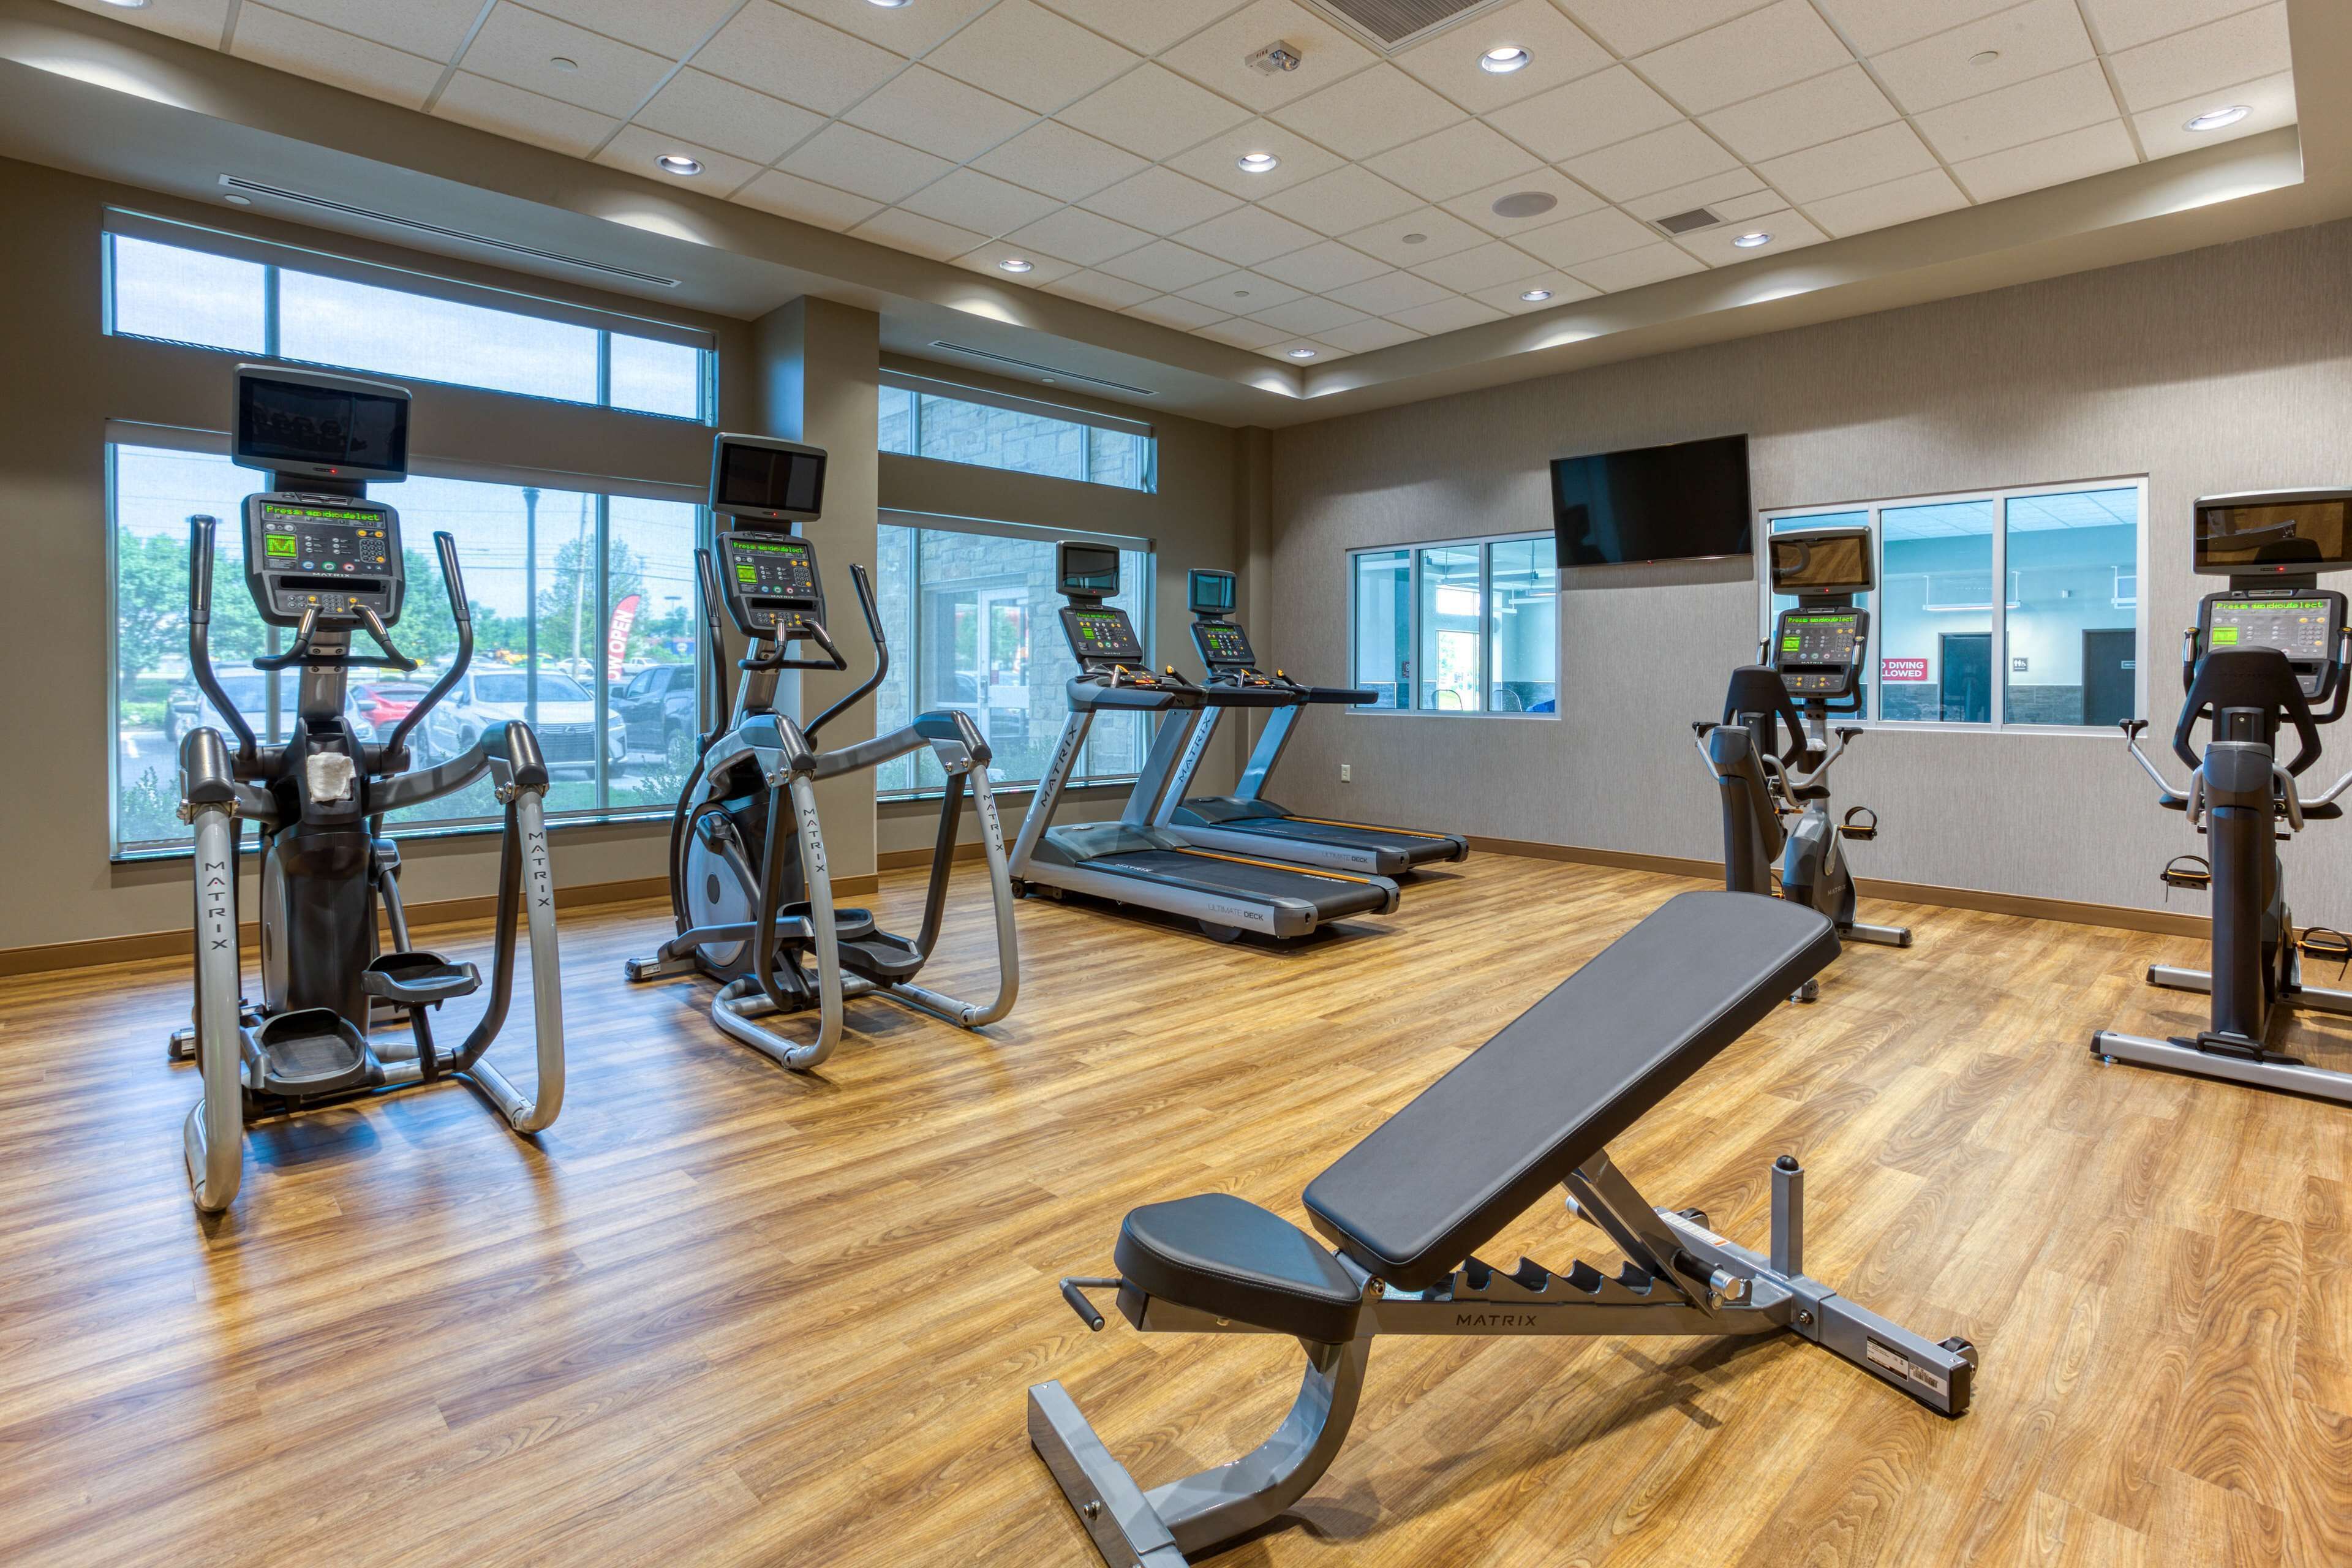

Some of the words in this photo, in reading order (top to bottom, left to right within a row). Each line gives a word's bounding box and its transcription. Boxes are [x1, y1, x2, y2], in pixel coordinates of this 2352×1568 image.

[608, 609, 635, 654] OPEN
[608, 654, 624, 681] OW
[1041, 725, 1077, 807] MATRIX
[1178, 715, 1211, 783] MATRIX
[803, 809, 826, 873] MATRIX
[983, 794, 1003, 851] MATRIX
[529, 832, 550, 907] MATRIX
[205, 861, 228, 950] MATRIX
[1207, 903, 1242, 917] ULTIMATE
[1243, 911, 1264, 921] DECK
[1456, 1314, 1537, 1326] MATRIX
